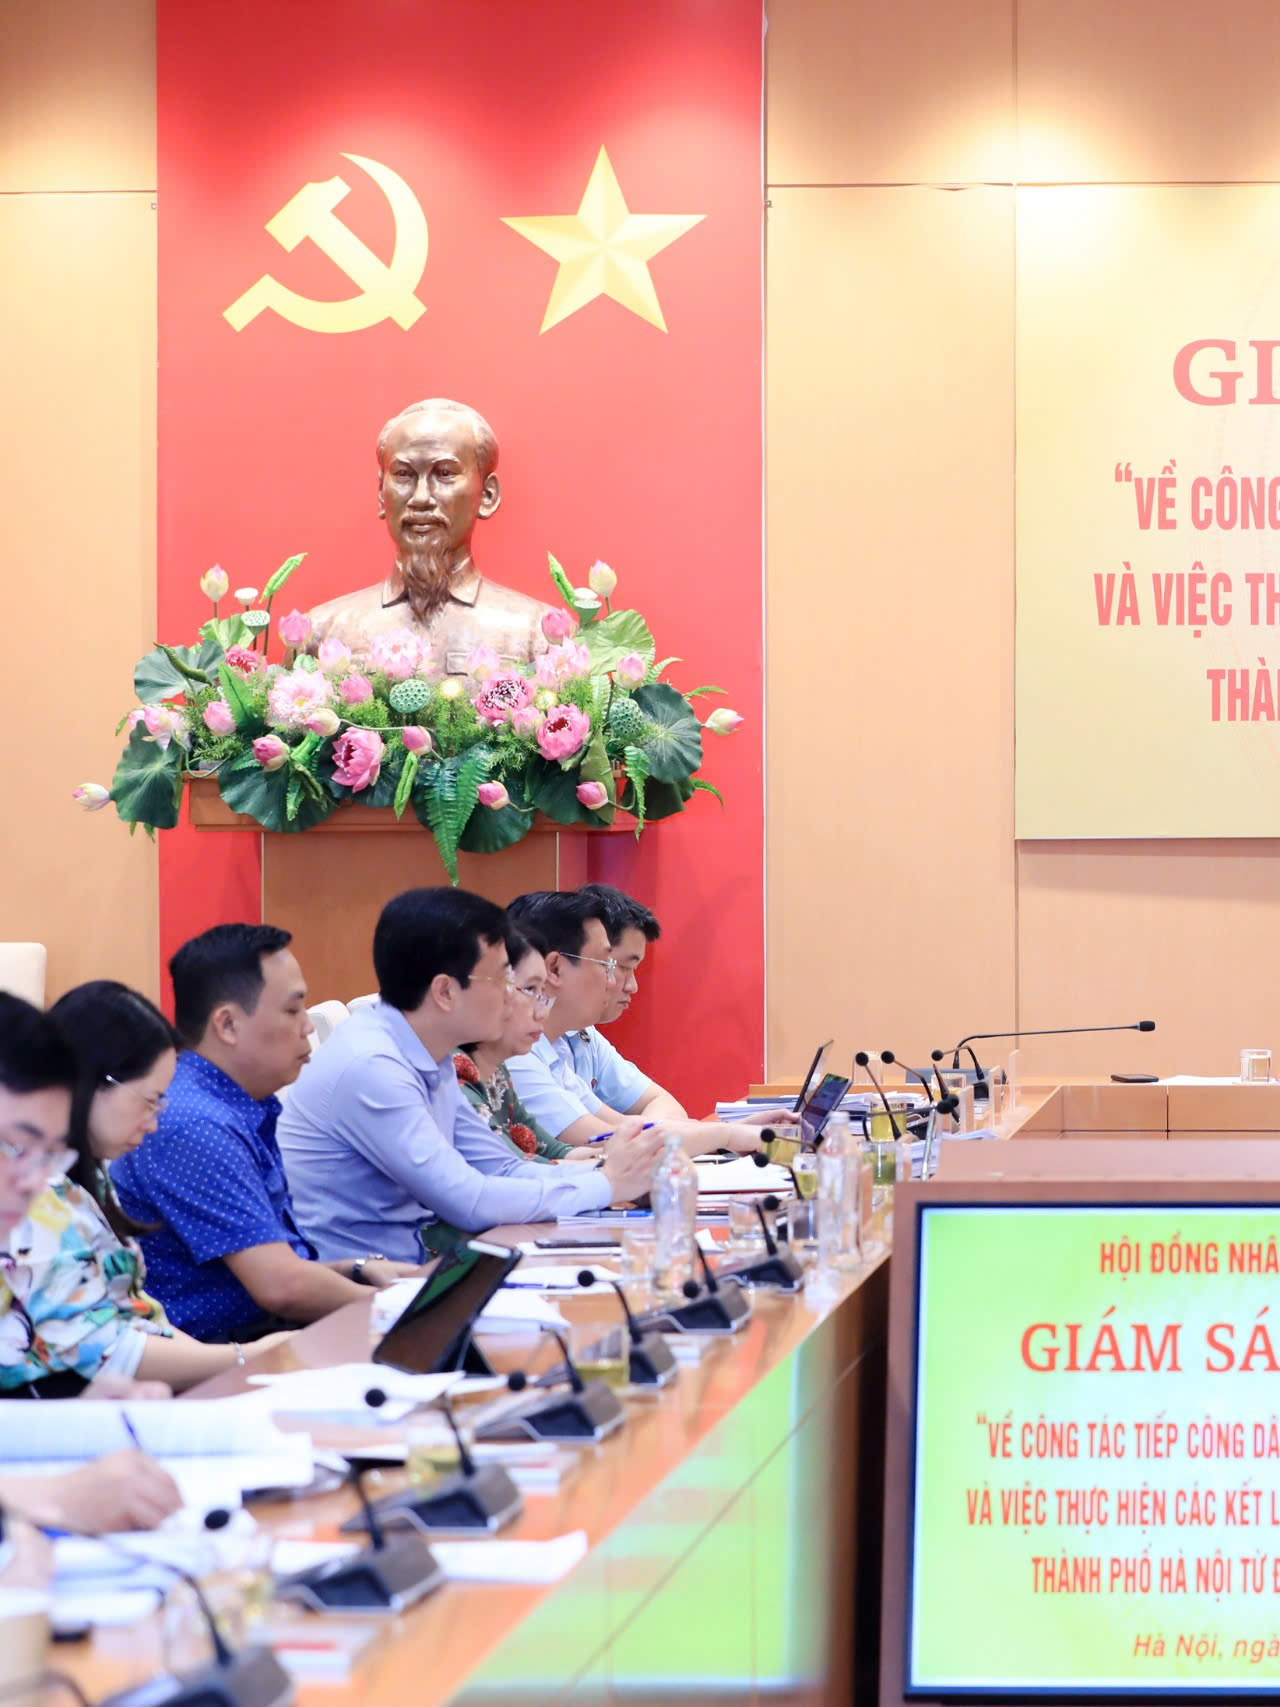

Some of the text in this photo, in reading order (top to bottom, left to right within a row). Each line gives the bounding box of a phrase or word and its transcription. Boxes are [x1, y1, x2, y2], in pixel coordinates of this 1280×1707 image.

[1115, 460, 1177, 530] “VỀ
[1094, 561, 1141, 626] VÀ
[1152, 562, 1232, 638] VIỆC
[1100, 1235, 1140, 1281] HỘI
[1150, 1230, 1218, 1273] ĐỒNG
[1021, 1306, 1182, 1371] GIÁM
[977, 1410, 1012, 1458] “VỀ
[1021, 1414, 1078, 1458] CÔNG
[1087, 1414, 1125, 1458] TÁC
[1134, 1410, 1178, 1458] TIẾP
[1187, 1415, 1244, 1458] CÔNG
[967, 1481, 992, 1526] VÀ
[1001, 1482, 1047, 1534] VIỆC
[1055, 1486, 1108, 1535] THỰC
[1116, 1482, 1166, 1534] HIỆN
[1175, 1482, 1216, 1526] CÁC
[1224, 1477, 1262, 1526] KẾT
[1031, 1549, 1102, 1593] THÀNH
[1110, 1543, 1151, 1593] PHỐ
[1159, 1549, 1187, 1593] HÀ
[1196, 1549, 1231, 1602] NỘI
[1240, 1549, 1267, 1594] TỪ
[1133, 1634, 1166, 1658] Hà
[1176, 1633, 1223, 1664] Nội,
